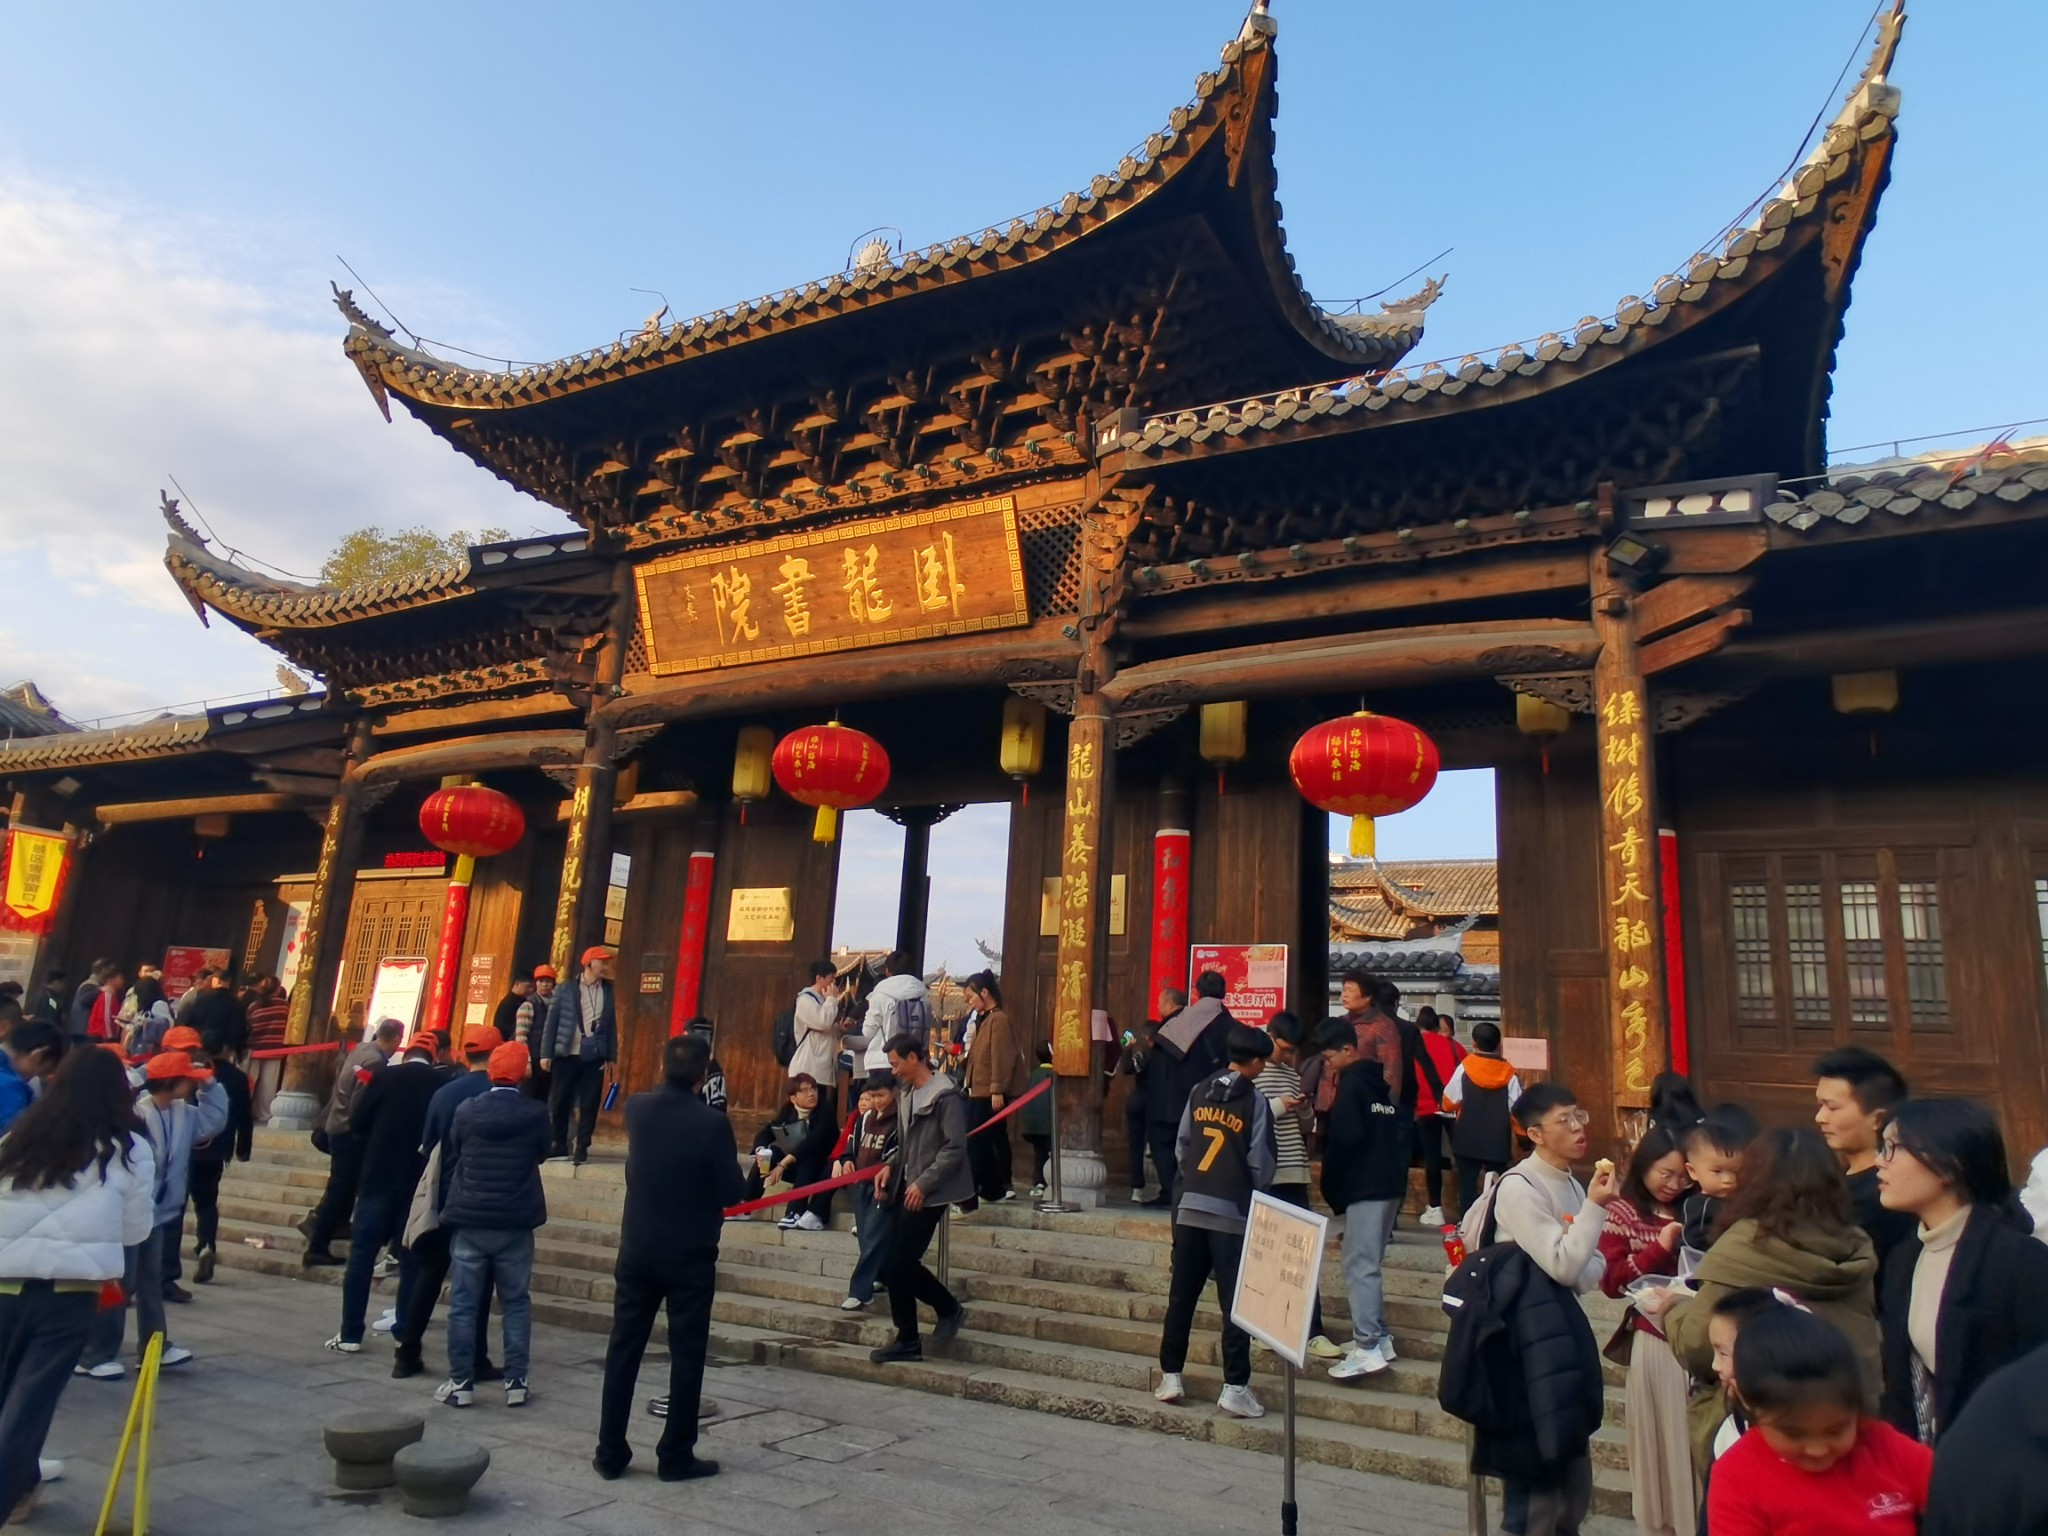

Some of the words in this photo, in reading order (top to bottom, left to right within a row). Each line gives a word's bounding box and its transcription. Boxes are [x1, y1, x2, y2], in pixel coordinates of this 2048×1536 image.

[1349, 728, 1362, 772] 福山福海
[1197, 1127, 1225, 1172] 7
